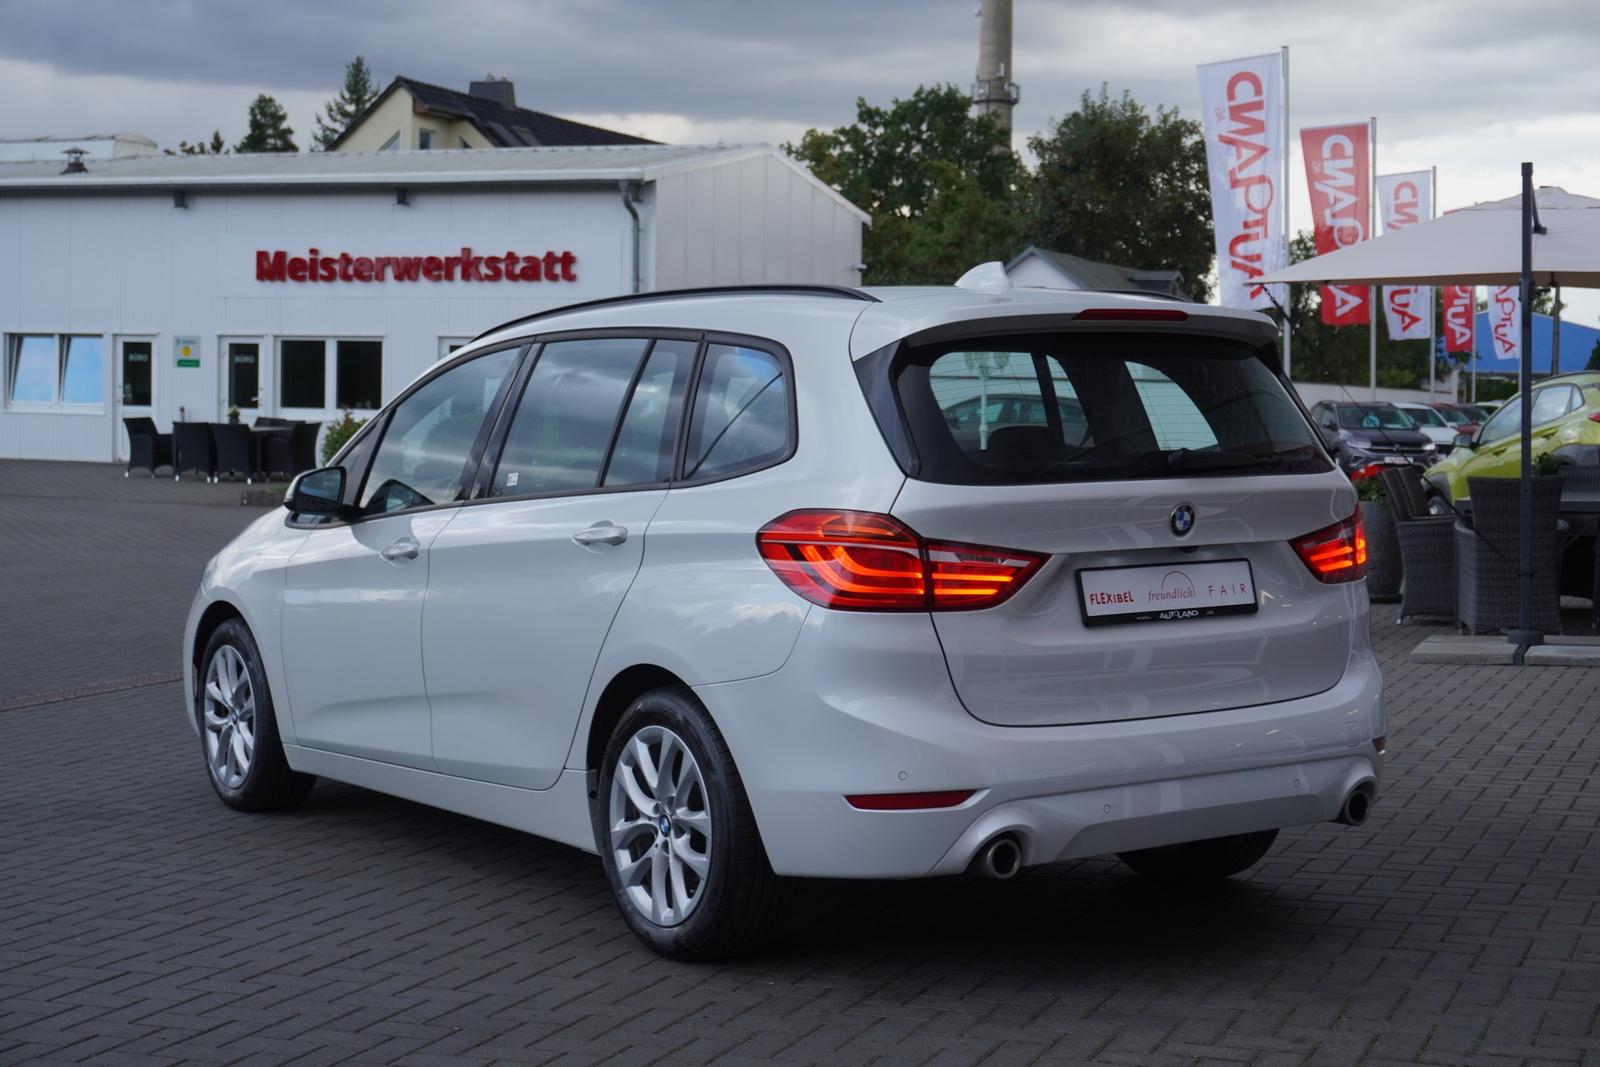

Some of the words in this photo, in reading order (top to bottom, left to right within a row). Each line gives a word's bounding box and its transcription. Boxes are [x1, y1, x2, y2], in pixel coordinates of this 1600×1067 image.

[256, 248, 577, 282] Meisterwerkstatt
[1090, 591, 1134, 605] FLEXIBEL
[1148, 587, 1194, 604] freundlich
